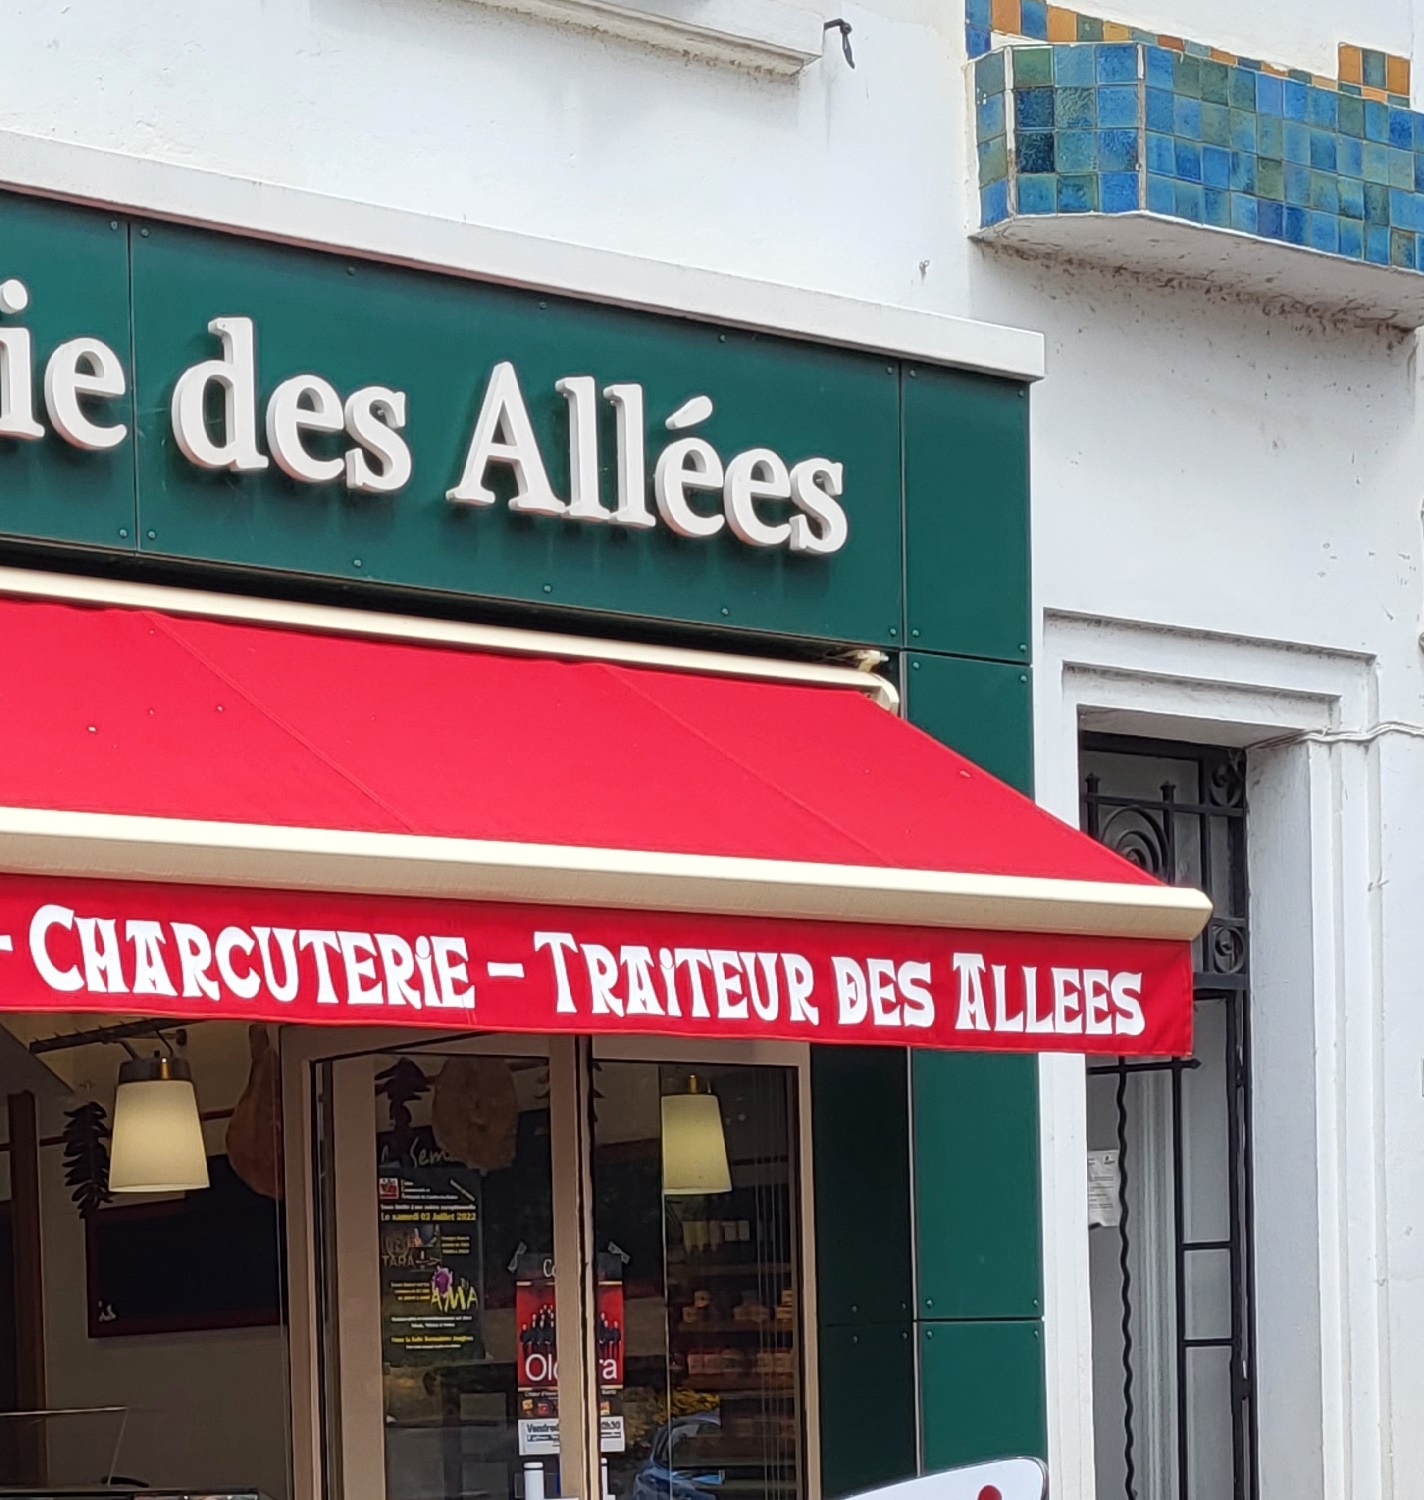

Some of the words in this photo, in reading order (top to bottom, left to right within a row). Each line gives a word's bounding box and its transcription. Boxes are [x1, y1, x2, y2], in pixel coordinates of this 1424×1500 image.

[172, 316, 413, 493] des
[445, 360, 849, 555] Allées
[832, 956, 935, 1028] DES
[952, 951, 1147, 1036] ALLEES
[526, 1421, 560, 1434] Vendred
